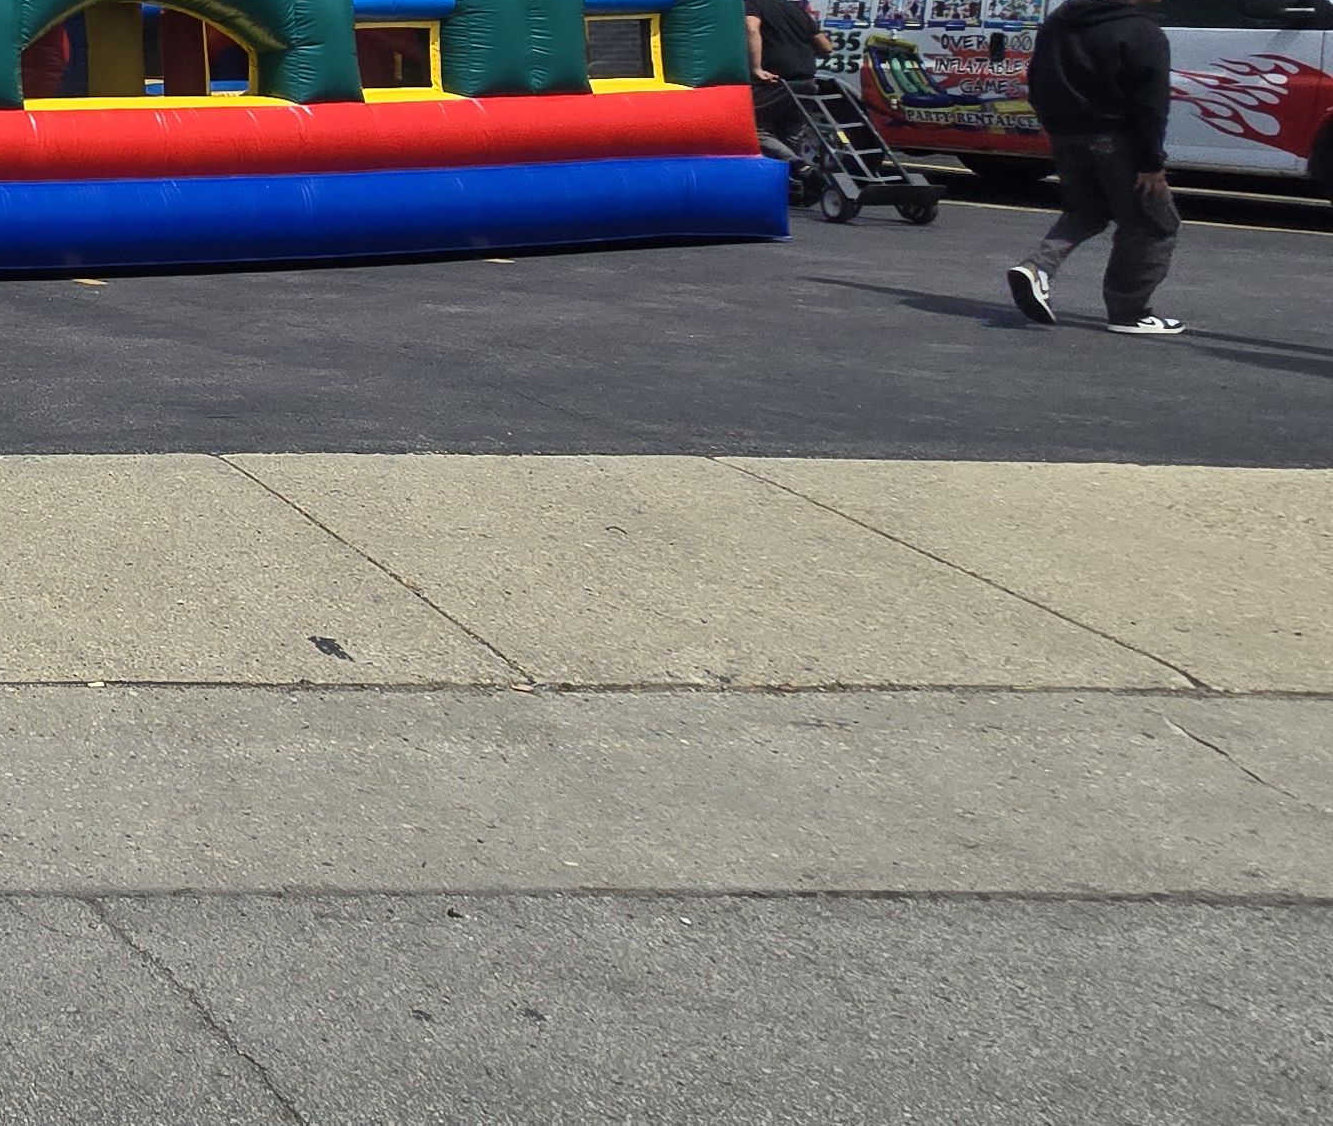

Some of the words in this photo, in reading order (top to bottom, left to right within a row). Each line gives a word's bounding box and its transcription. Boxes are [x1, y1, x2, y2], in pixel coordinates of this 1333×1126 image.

[941, 34, 987, 50] OVER
[960, 80, 1021, 94] GAMES
[907, 110, 950, 122] PARTY
